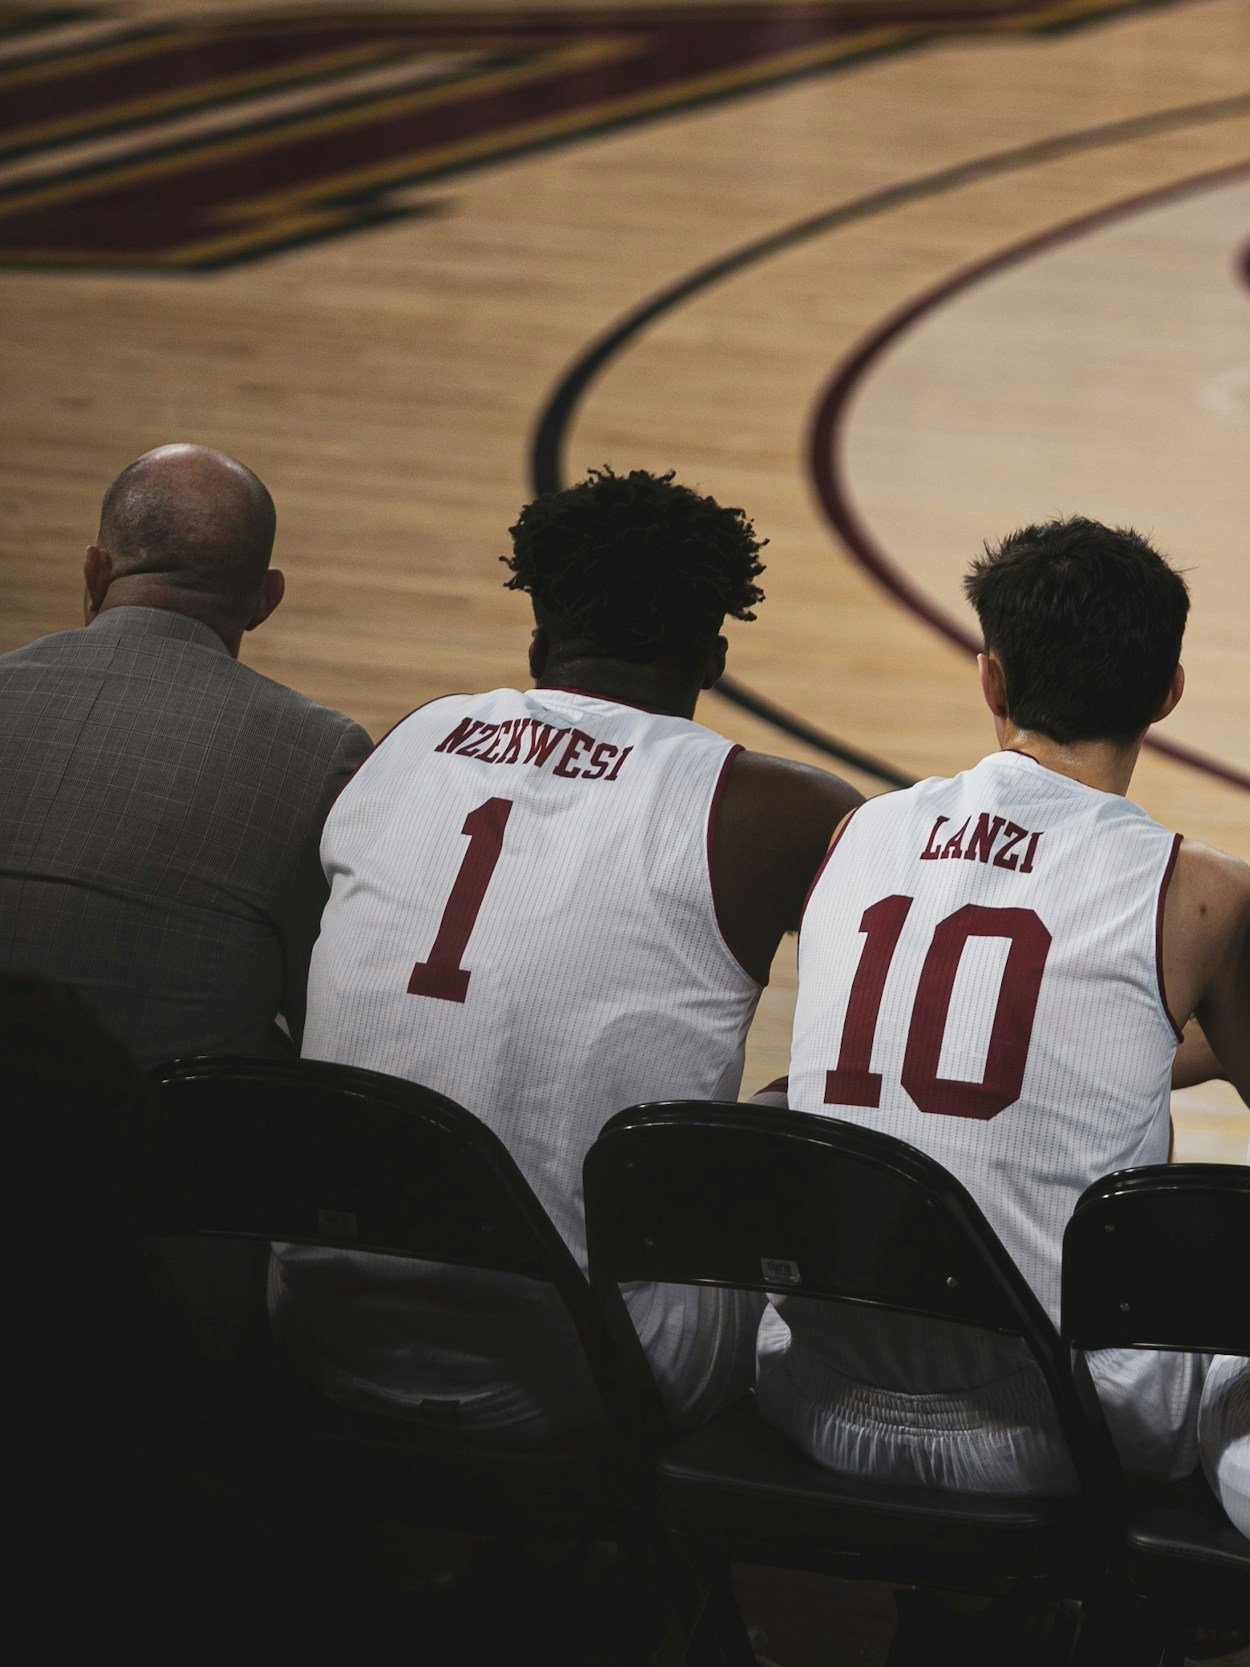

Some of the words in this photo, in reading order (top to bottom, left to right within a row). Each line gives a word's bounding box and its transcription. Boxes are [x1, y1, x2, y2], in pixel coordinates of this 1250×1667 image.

[434, 717, 634, 781] NZEKWESI
[407, 797, 512, 1004] 1
[920, 812, 1043, 874] LANZI
[824, 894, 1052, 1121] 10
